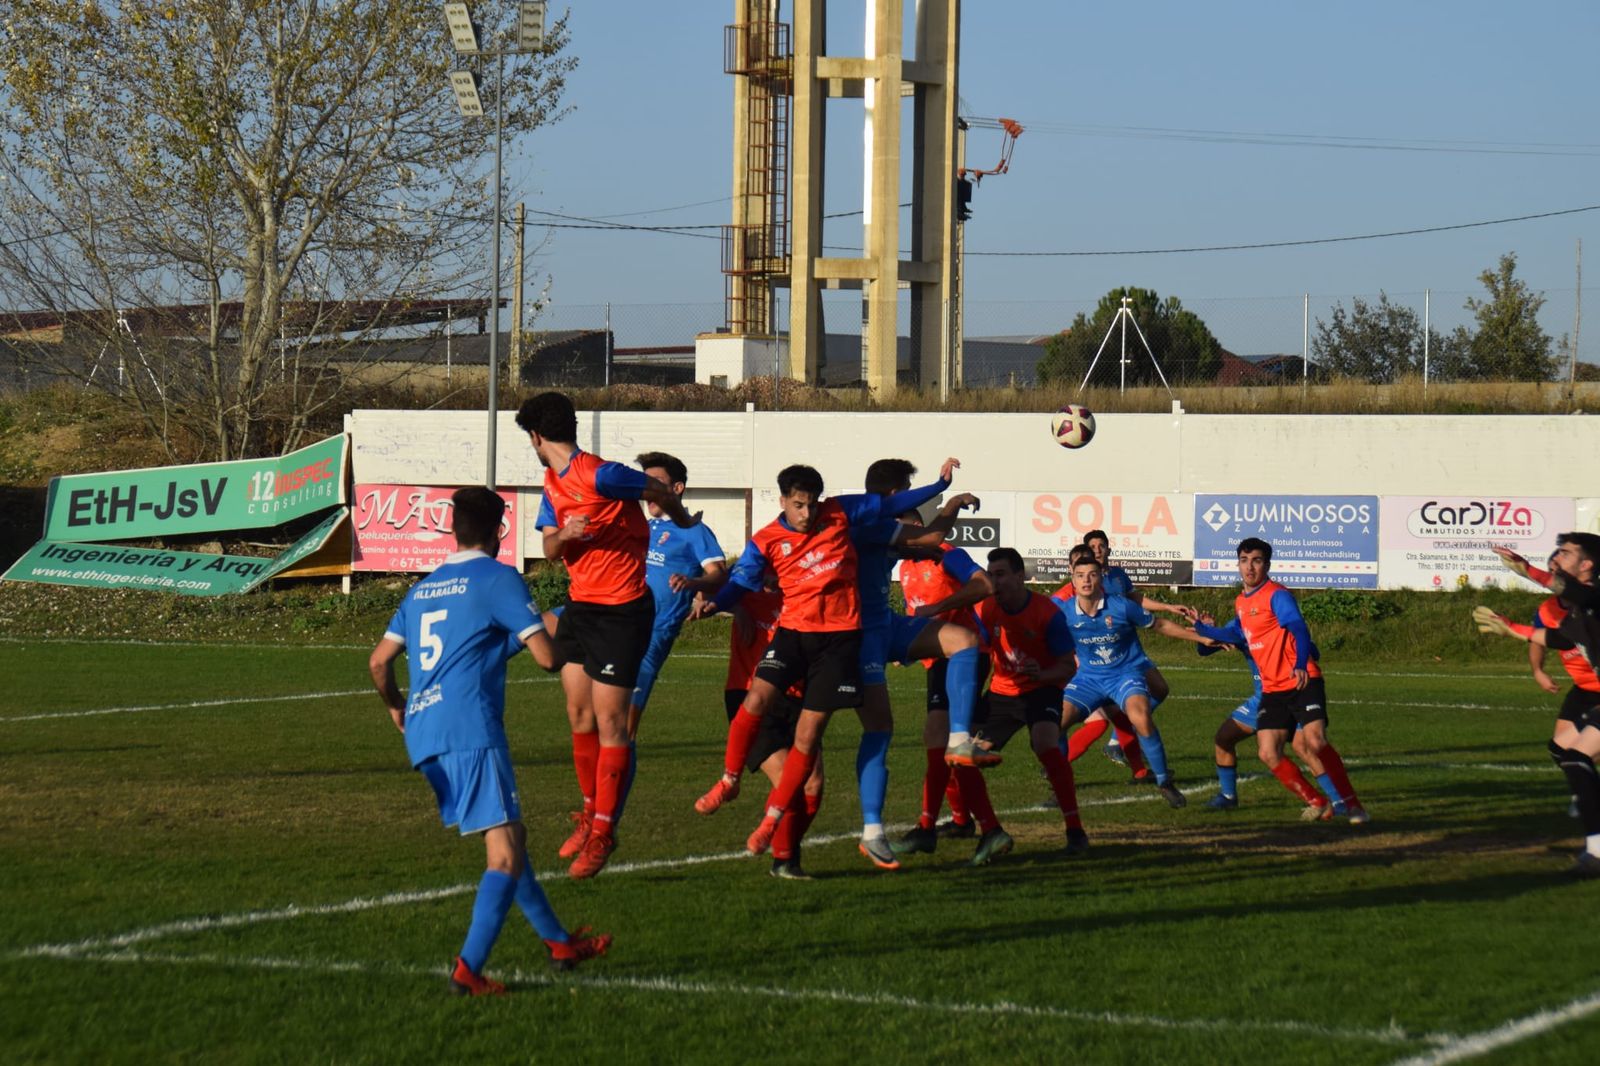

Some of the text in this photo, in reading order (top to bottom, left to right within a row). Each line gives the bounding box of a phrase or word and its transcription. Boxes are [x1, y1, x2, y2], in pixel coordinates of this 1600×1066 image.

[67, 477, 228, 527] EtH-JsV
[248, 482, 332, 514] consulting
[1031, 494, 1178, 536] SOLA
[1234, 503, 1370, 523] LUMINOSOS
[388, 546, 398, 554] de
[401, 546, 409, 554] la
[1302, 539, 1343, 547] Luminosos
[40, 543, 177, 568] Ingeniería
[178, 558, 201, 572] y
[400, 557, 423, 568] 675
[1110, 550, 1157, 558] XCAVACIONES
[1276, 550, 1298, 558] Textil
[1304, 550, 1360, 560] Merchandising
[419, 609, 448, 671] 5
